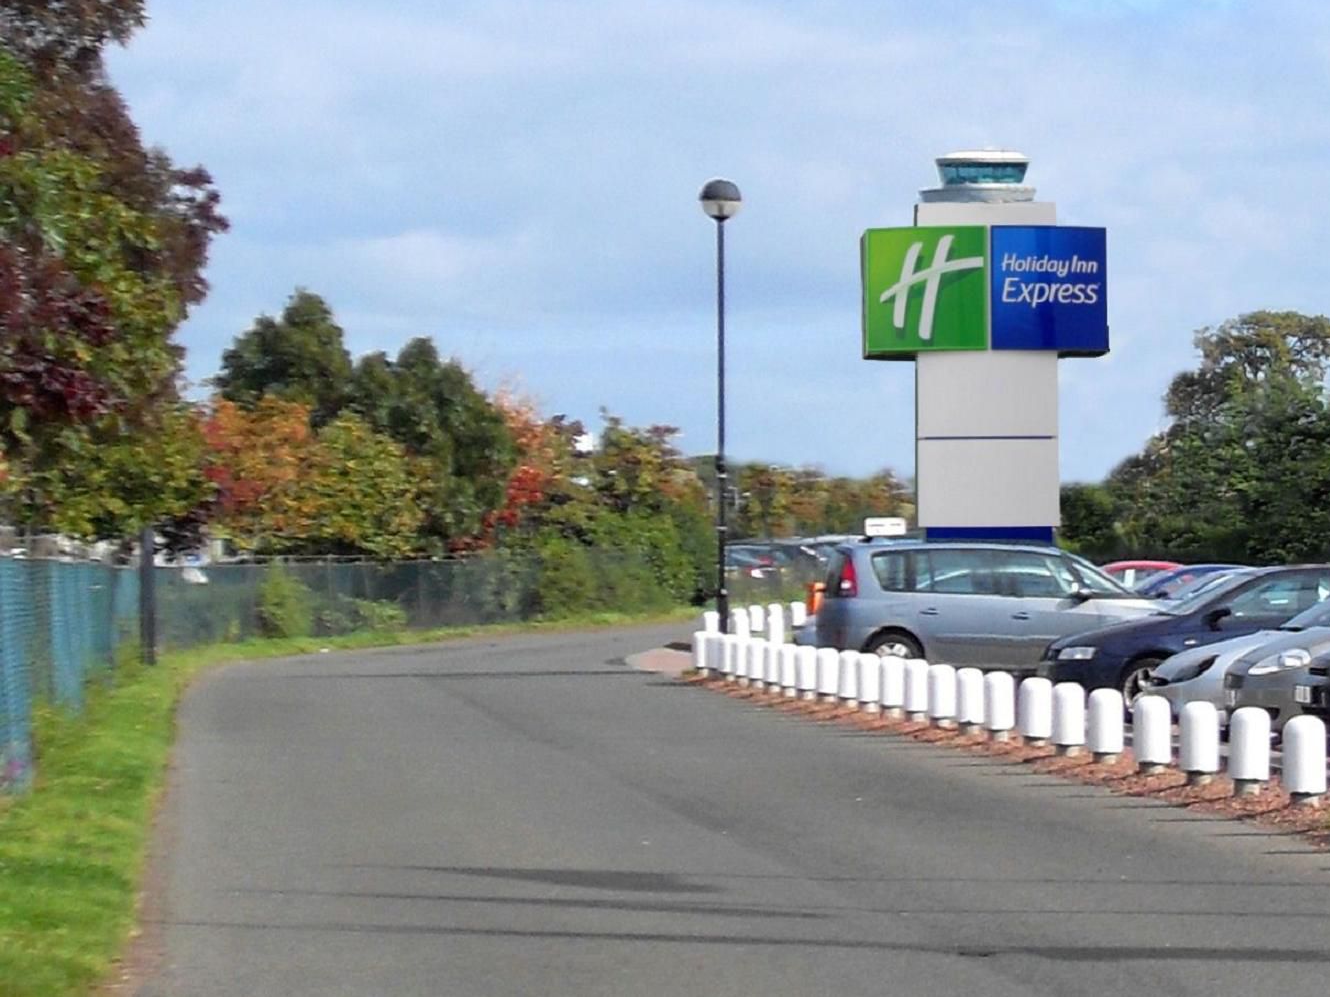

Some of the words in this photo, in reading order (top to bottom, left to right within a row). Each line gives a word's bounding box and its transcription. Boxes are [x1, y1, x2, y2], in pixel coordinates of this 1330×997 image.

[1001, 252, 1070, 277] Holiday
[1070, 254, 1098, 274] Inn
[1002, 277, 1098, 308] Express
